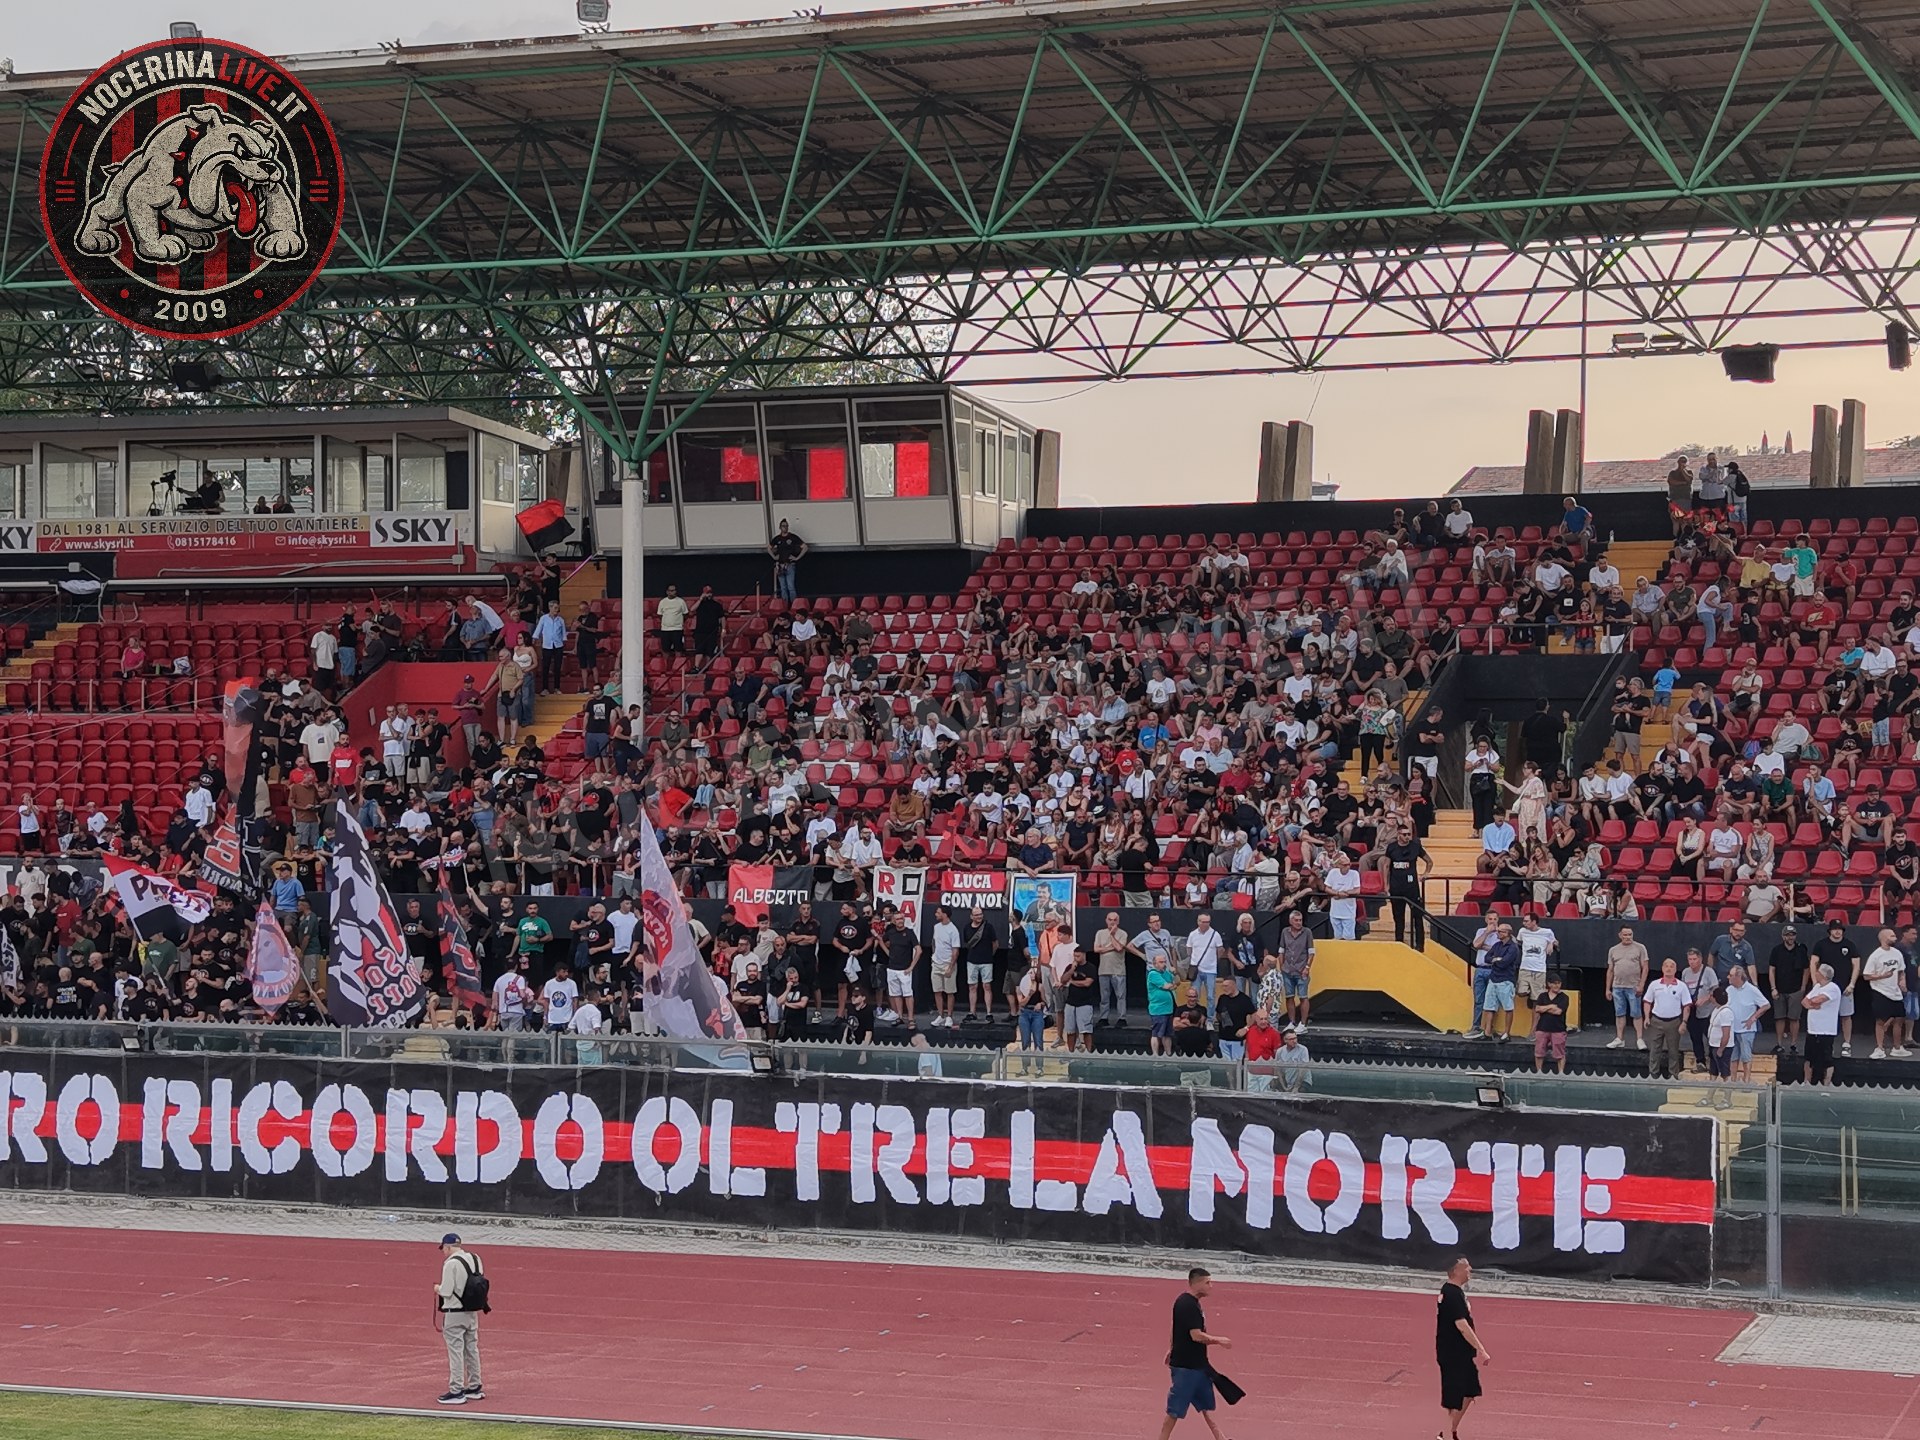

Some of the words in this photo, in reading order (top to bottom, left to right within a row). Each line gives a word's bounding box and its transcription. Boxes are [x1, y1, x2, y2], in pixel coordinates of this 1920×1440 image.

[42, 523, 69, 536] DAL
[78, 523, 110, 535] 1981
[117, 522, 135, 534] AL
[141, 520, 210, 534] SERVIZIO
[216, 520, 243, 533] DEL
[247, 519, 278, 532] TUO
[284, 517, 365, 532] CANTIERE.
[392, 517, 453, 543] SKY
[65, 538, 135, 551] www.skysrl.it
[174, 535, 237, 548] 0815178416
[288, 534, 357, 547] info@skysrl.it
[953, 874, 992, 889] LUCA
[733, 887, 808, 906] ALBERTO
[941, 892, 974, 909] CON
[975, 892, 1003, 909] NOI
[141, 1076, 604, 1190] RICORDO
[631, 1096, 986, 1205] OLTRE
[1008, 1108, 1164, 1219] LA
[1188, 1117, 1626, 1254] MORTE
